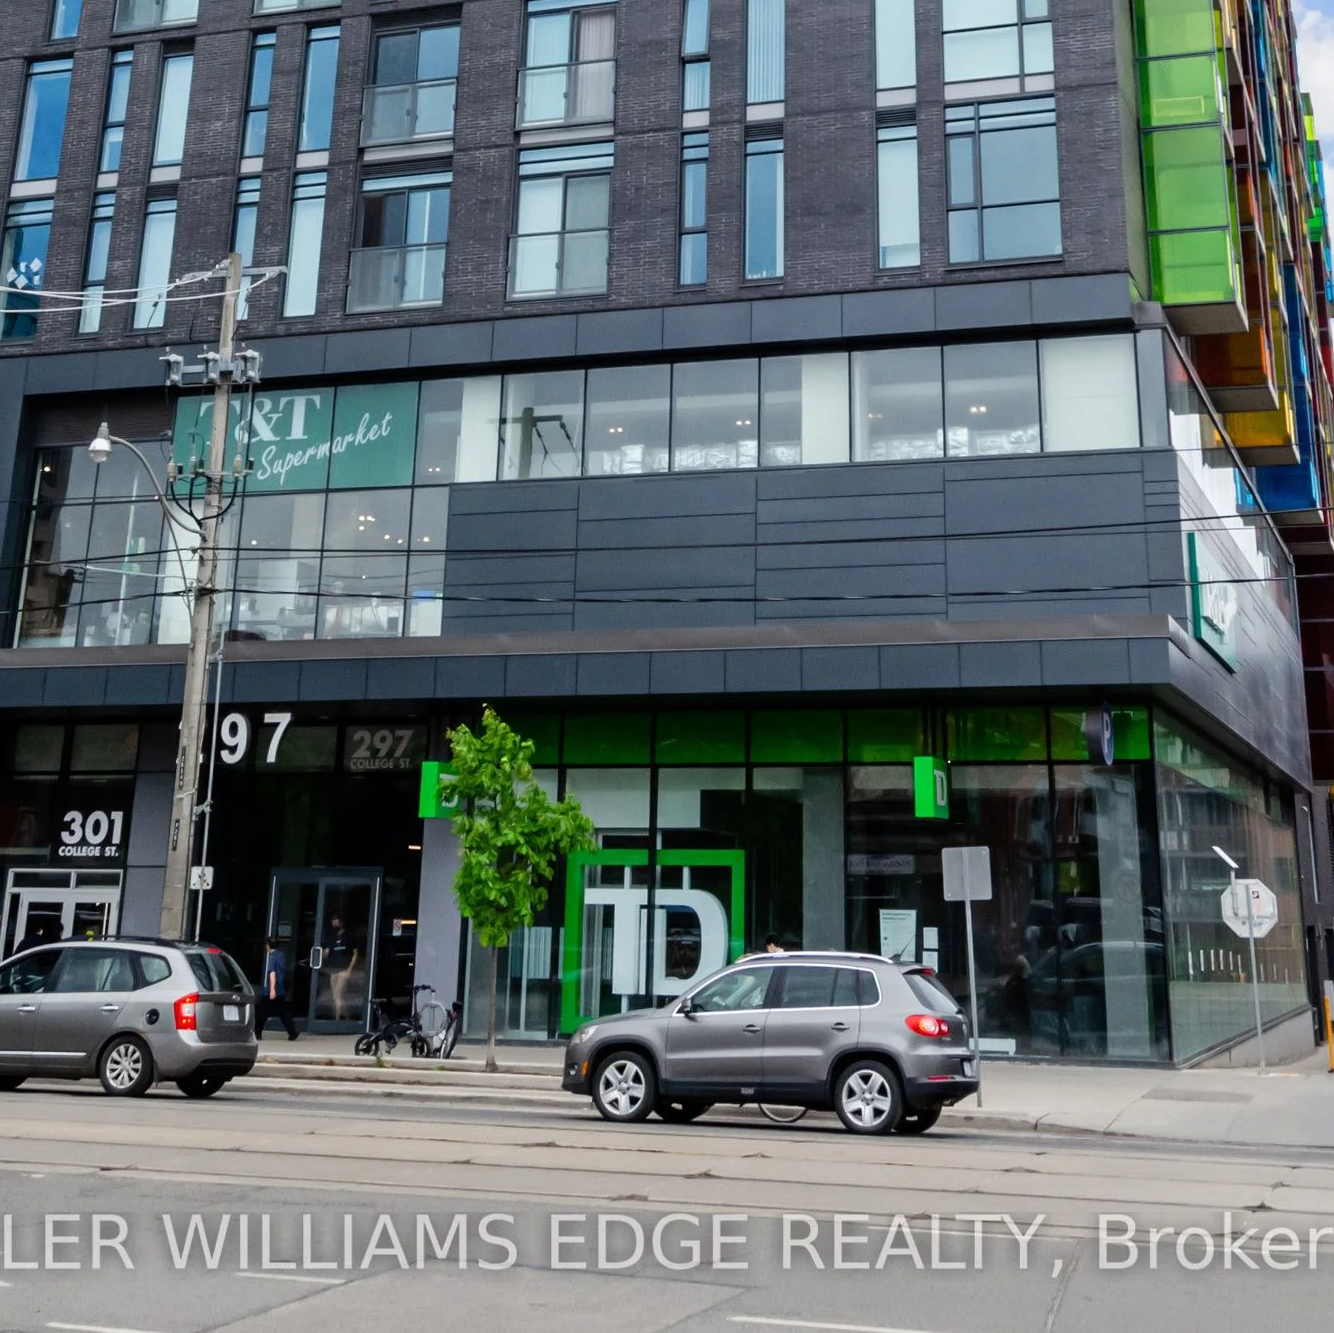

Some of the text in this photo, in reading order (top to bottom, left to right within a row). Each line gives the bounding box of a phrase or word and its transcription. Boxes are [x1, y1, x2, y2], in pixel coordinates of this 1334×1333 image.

[257, 412, 393, 485] Supermarket
[351, 730, 414, 758] 297
[350, 758, 395, 770] COLLEGE
[61, 810, 123, 845] 301
[58, 846, 119, 857] COLLEGE ST.
[584, 889, 729, 995] TD
